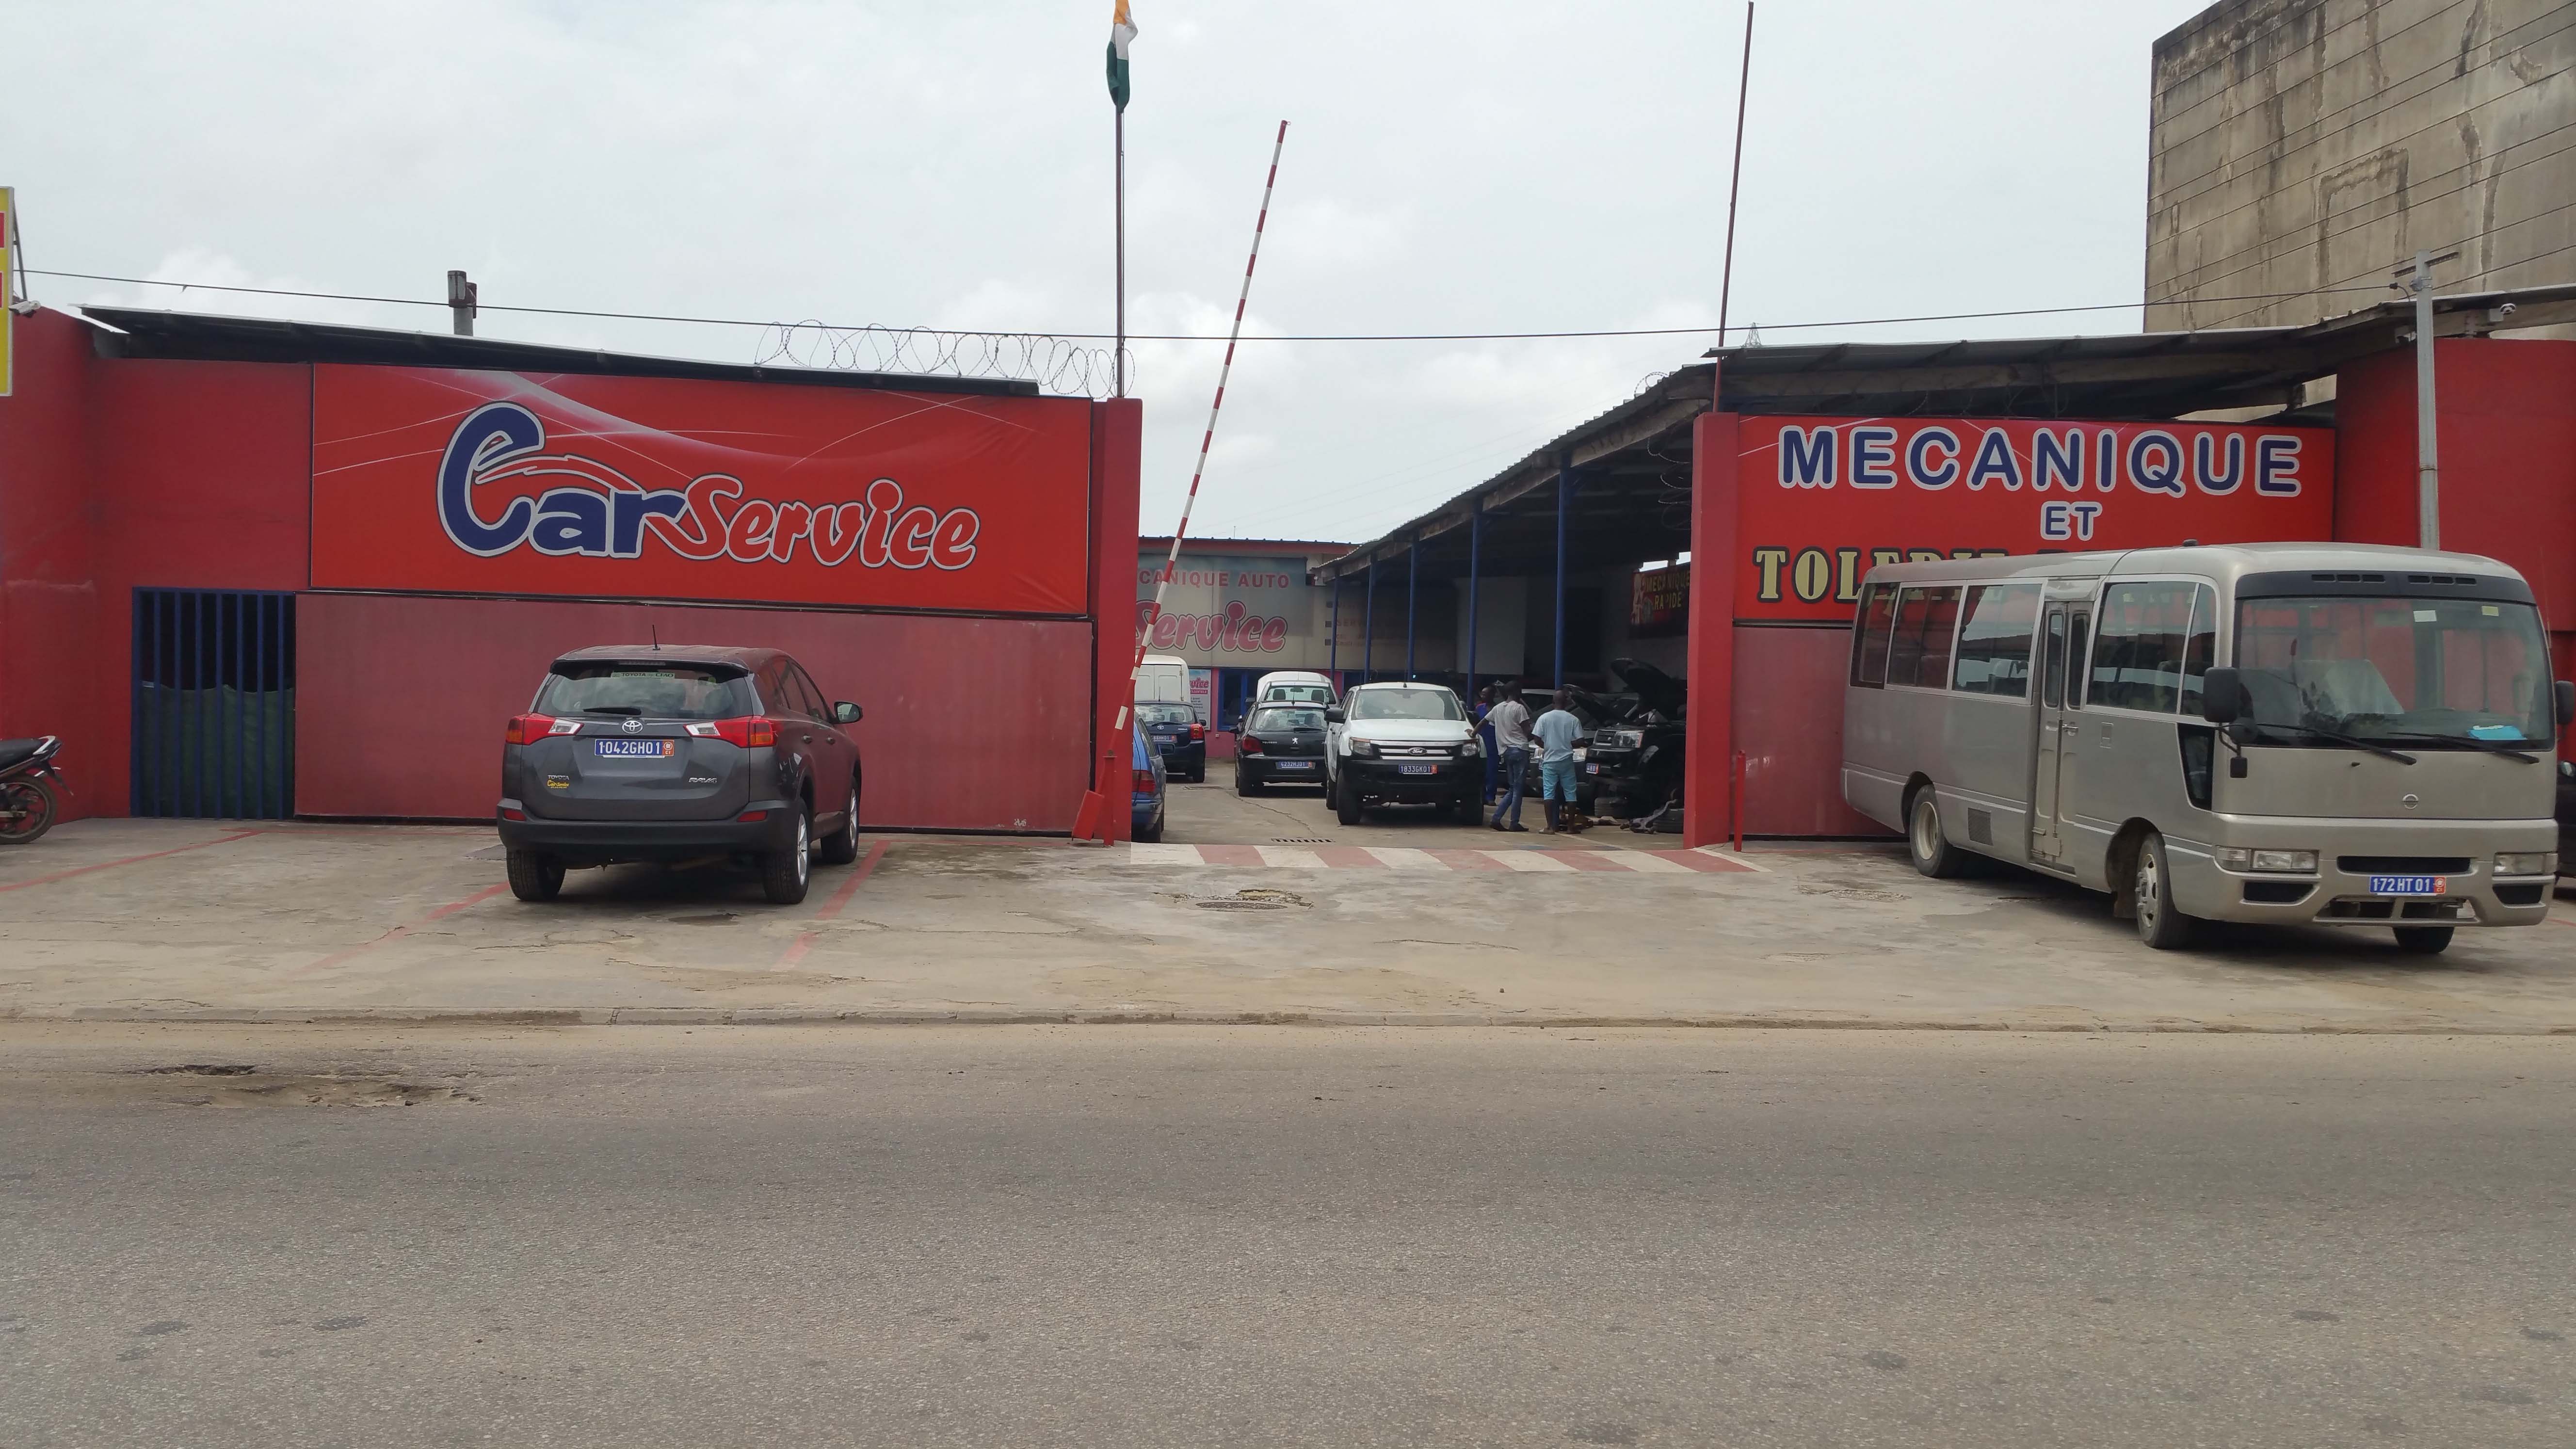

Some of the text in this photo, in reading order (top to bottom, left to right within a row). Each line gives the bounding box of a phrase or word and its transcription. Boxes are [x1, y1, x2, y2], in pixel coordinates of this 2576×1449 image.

[1778, 425, 2302, 498] MECANIQUE
[438, 402, 980, 569] Car Service
[2040, 501, 2102, 541] ET
[1238, 574, 1289, 588] AUTO
[1136, 599, 1288, 653] Service
[599, 741, 660, 755] 1042GH01
